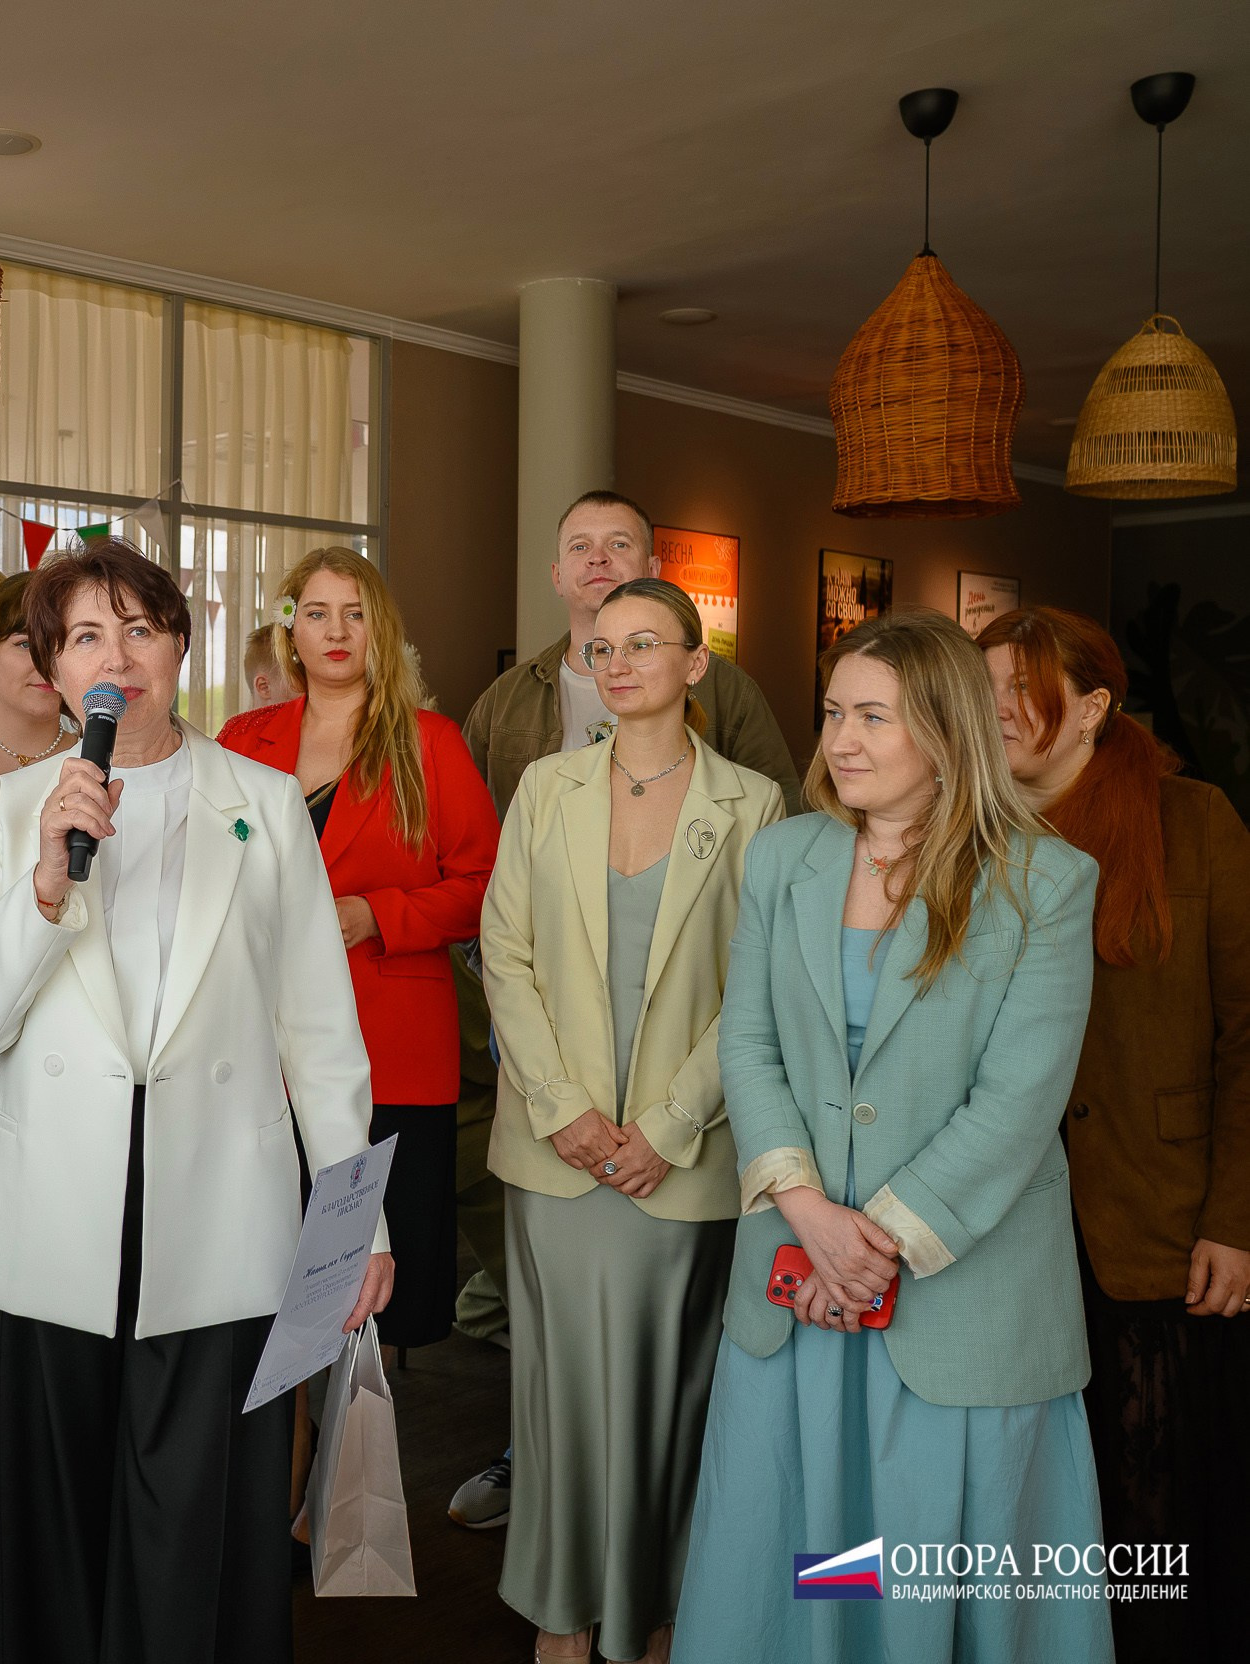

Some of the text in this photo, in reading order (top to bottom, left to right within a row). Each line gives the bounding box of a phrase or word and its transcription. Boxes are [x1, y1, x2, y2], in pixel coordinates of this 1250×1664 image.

[661, 540, 694, 566] ВЕСНА
[827, 585, 857, 603] МОЖНО
[826, 600, 865, 621] СО СВОИМ
